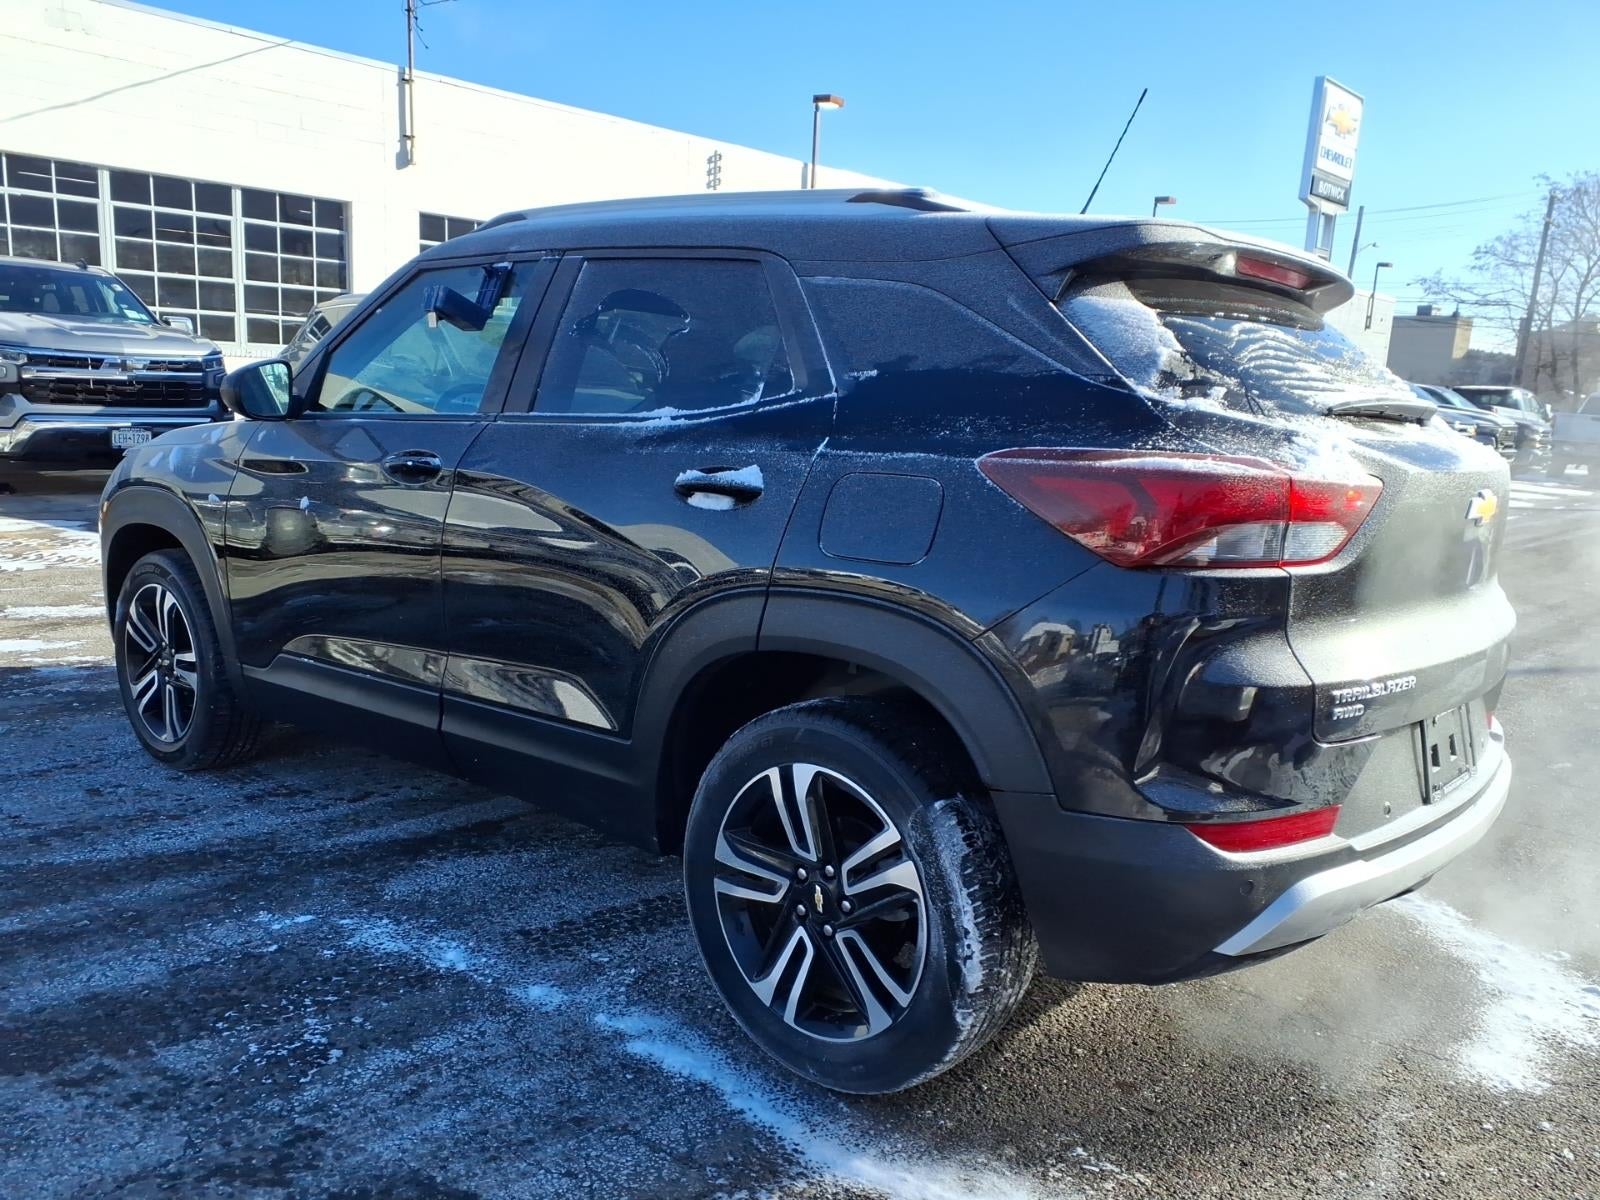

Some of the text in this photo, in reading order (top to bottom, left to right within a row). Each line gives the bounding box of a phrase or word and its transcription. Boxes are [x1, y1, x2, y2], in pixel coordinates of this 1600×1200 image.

[1320, 146, 1353, 168] CHEVROLET
[1318, 180, 1346, 200] BOTNICK
[1331, 675, 1417, 704] TRAILBLAZER
[1332, 703, 1365, 720] AWD
